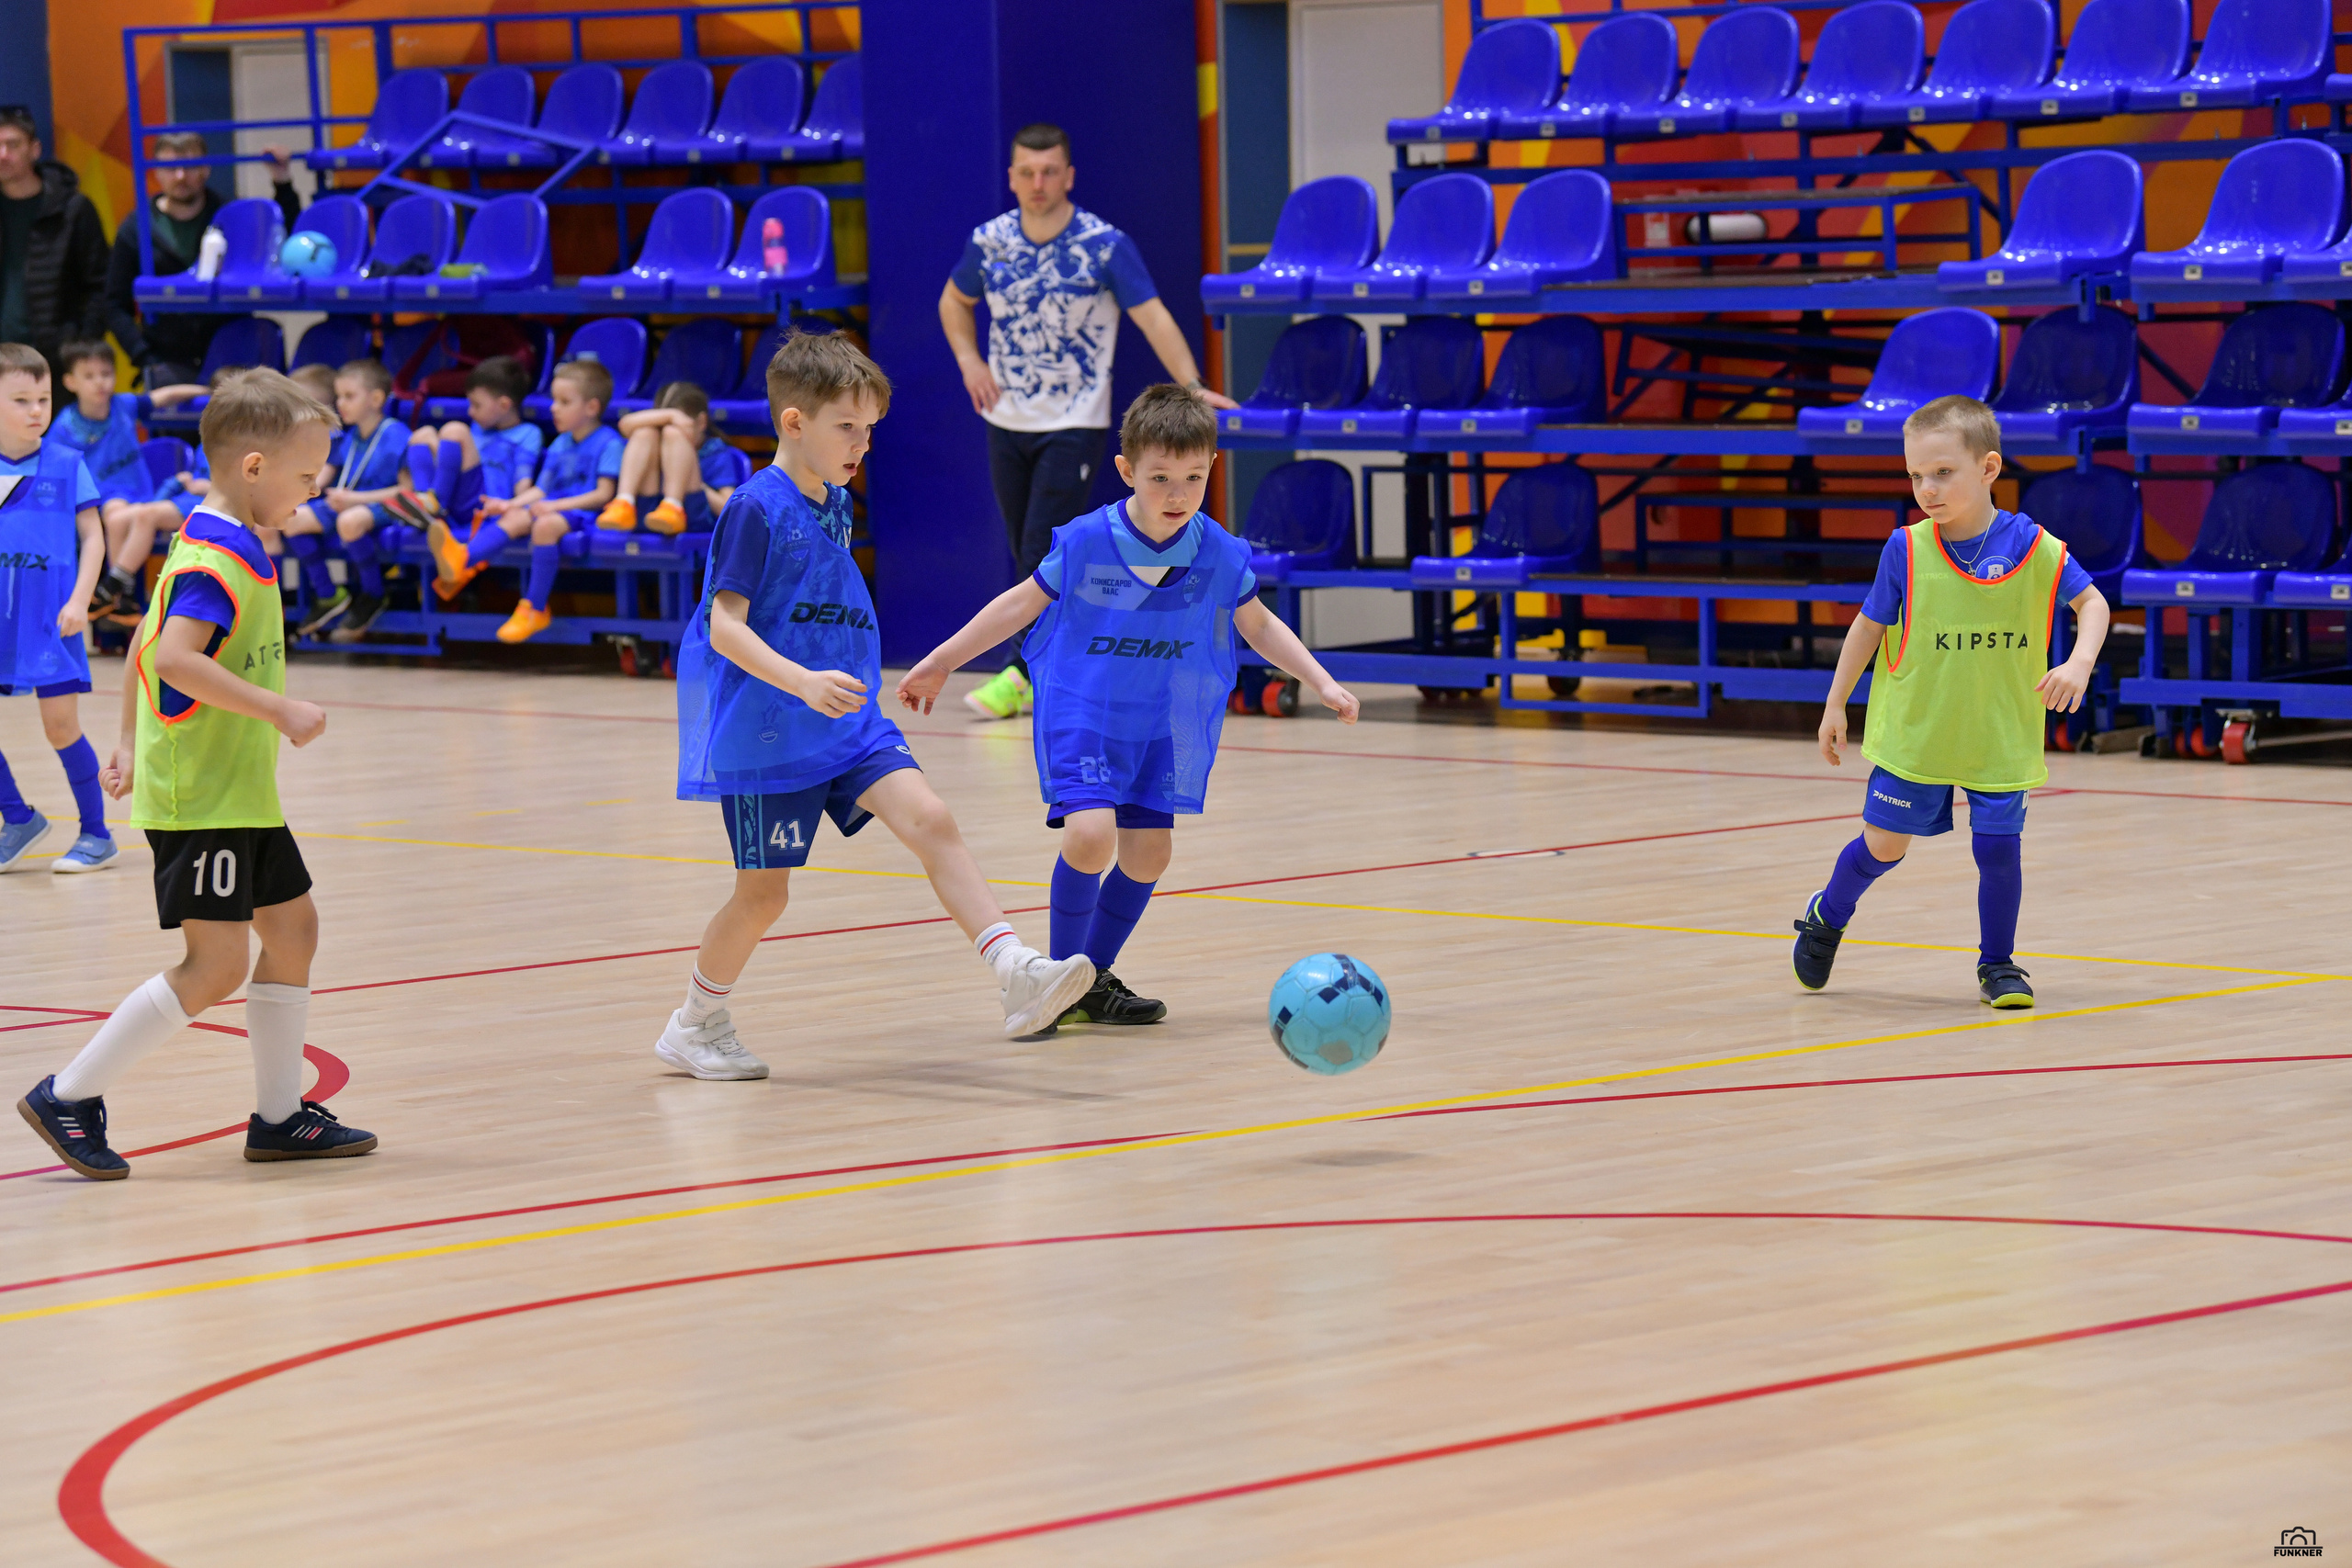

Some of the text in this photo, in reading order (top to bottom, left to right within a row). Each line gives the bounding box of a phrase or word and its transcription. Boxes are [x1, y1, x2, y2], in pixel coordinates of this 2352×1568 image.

[1935, 632, 2029, 650] KIPSTA
[1080, 756, 1112, 784] 28
[1877, 793, 1912, 809] PATRICK
[769, 818, 806, 850] 41
[193, 849, 237, 897] 10
